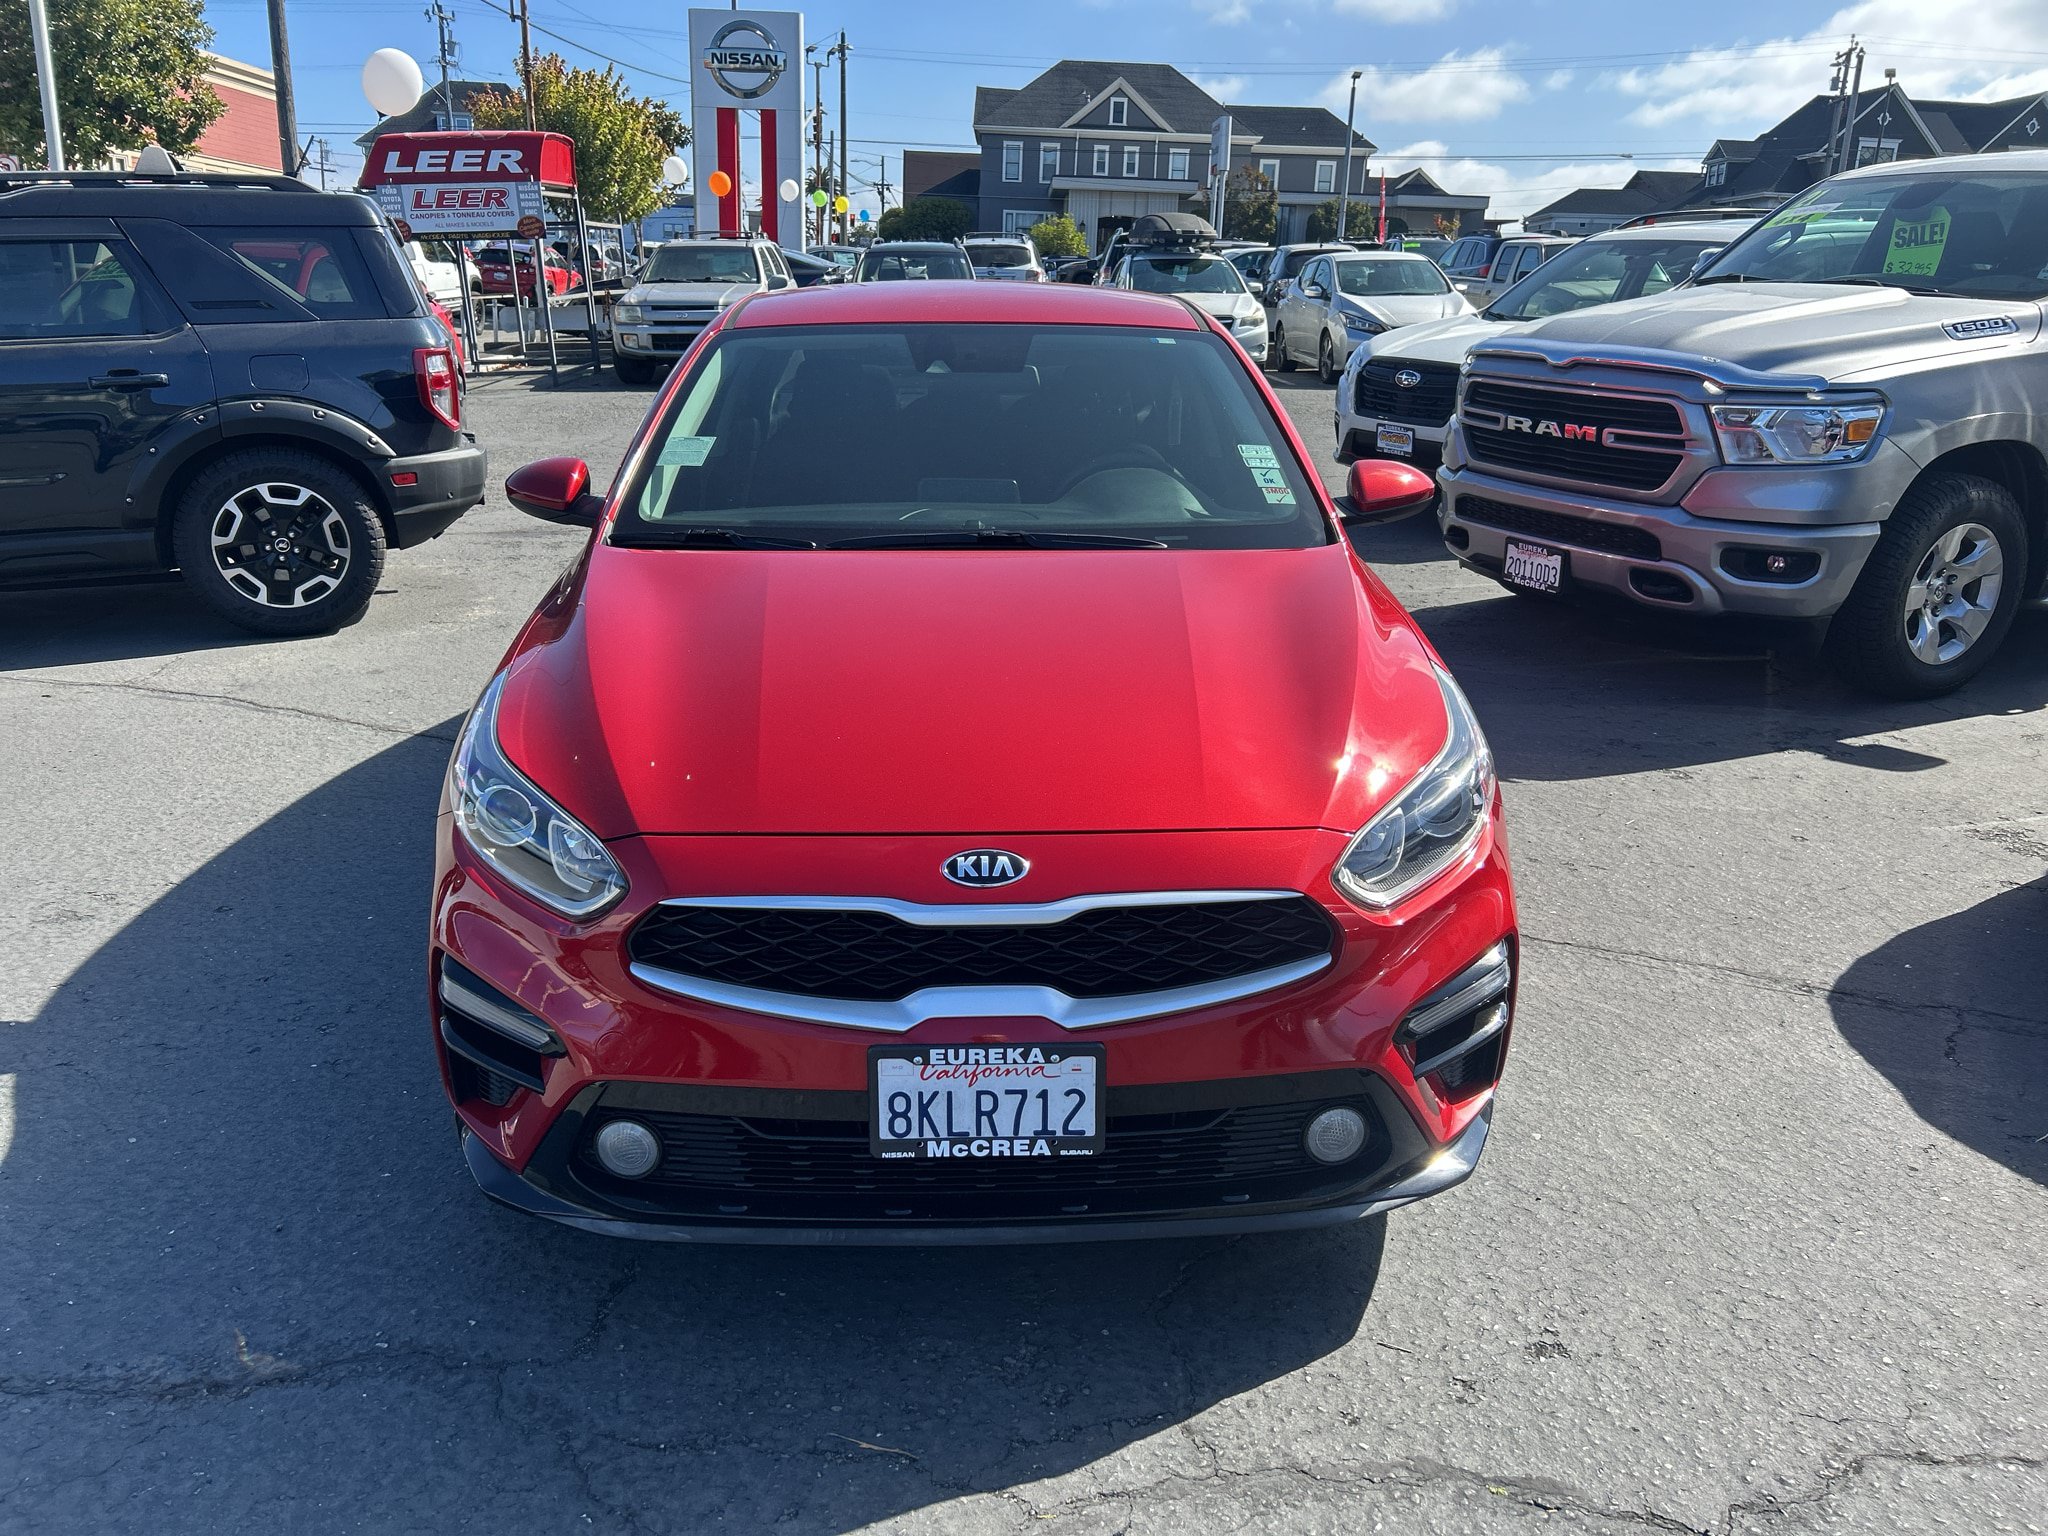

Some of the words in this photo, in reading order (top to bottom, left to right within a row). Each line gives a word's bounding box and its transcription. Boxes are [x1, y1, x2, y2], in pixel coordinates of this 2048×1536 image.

[711, 52, 778, 66] NISSAN
[384, 150, 523, 174] LEER
[411, 188, 510, 211] LEER
[409, 212, 446, 220] CANOPIES
[452, 211, 486, 219] TONNEAU
[486, 210, 515, 218] COVERS
[1894, 222, 1946, 249] SALE!
[1953, 319, 2004, 332] 1500
[1507, 415, 1597, 442] RAM
[1519, 543, 1547, 555] EUREKA
[1506, 556, 1558, 585] 20110D3
[1515, 577, 1545, 590] McCREA
[956, 855, 1015, 877] KIA
[929, 1047, 1045, 1064] EUREKA
[920, 1063, 1061, 1087] California
[887, 1088, 1086, 1138] 8KLR712
[881, 1150, 915, 1158] NISSAN
[927, 1139, 1051, 1157] McCREA
